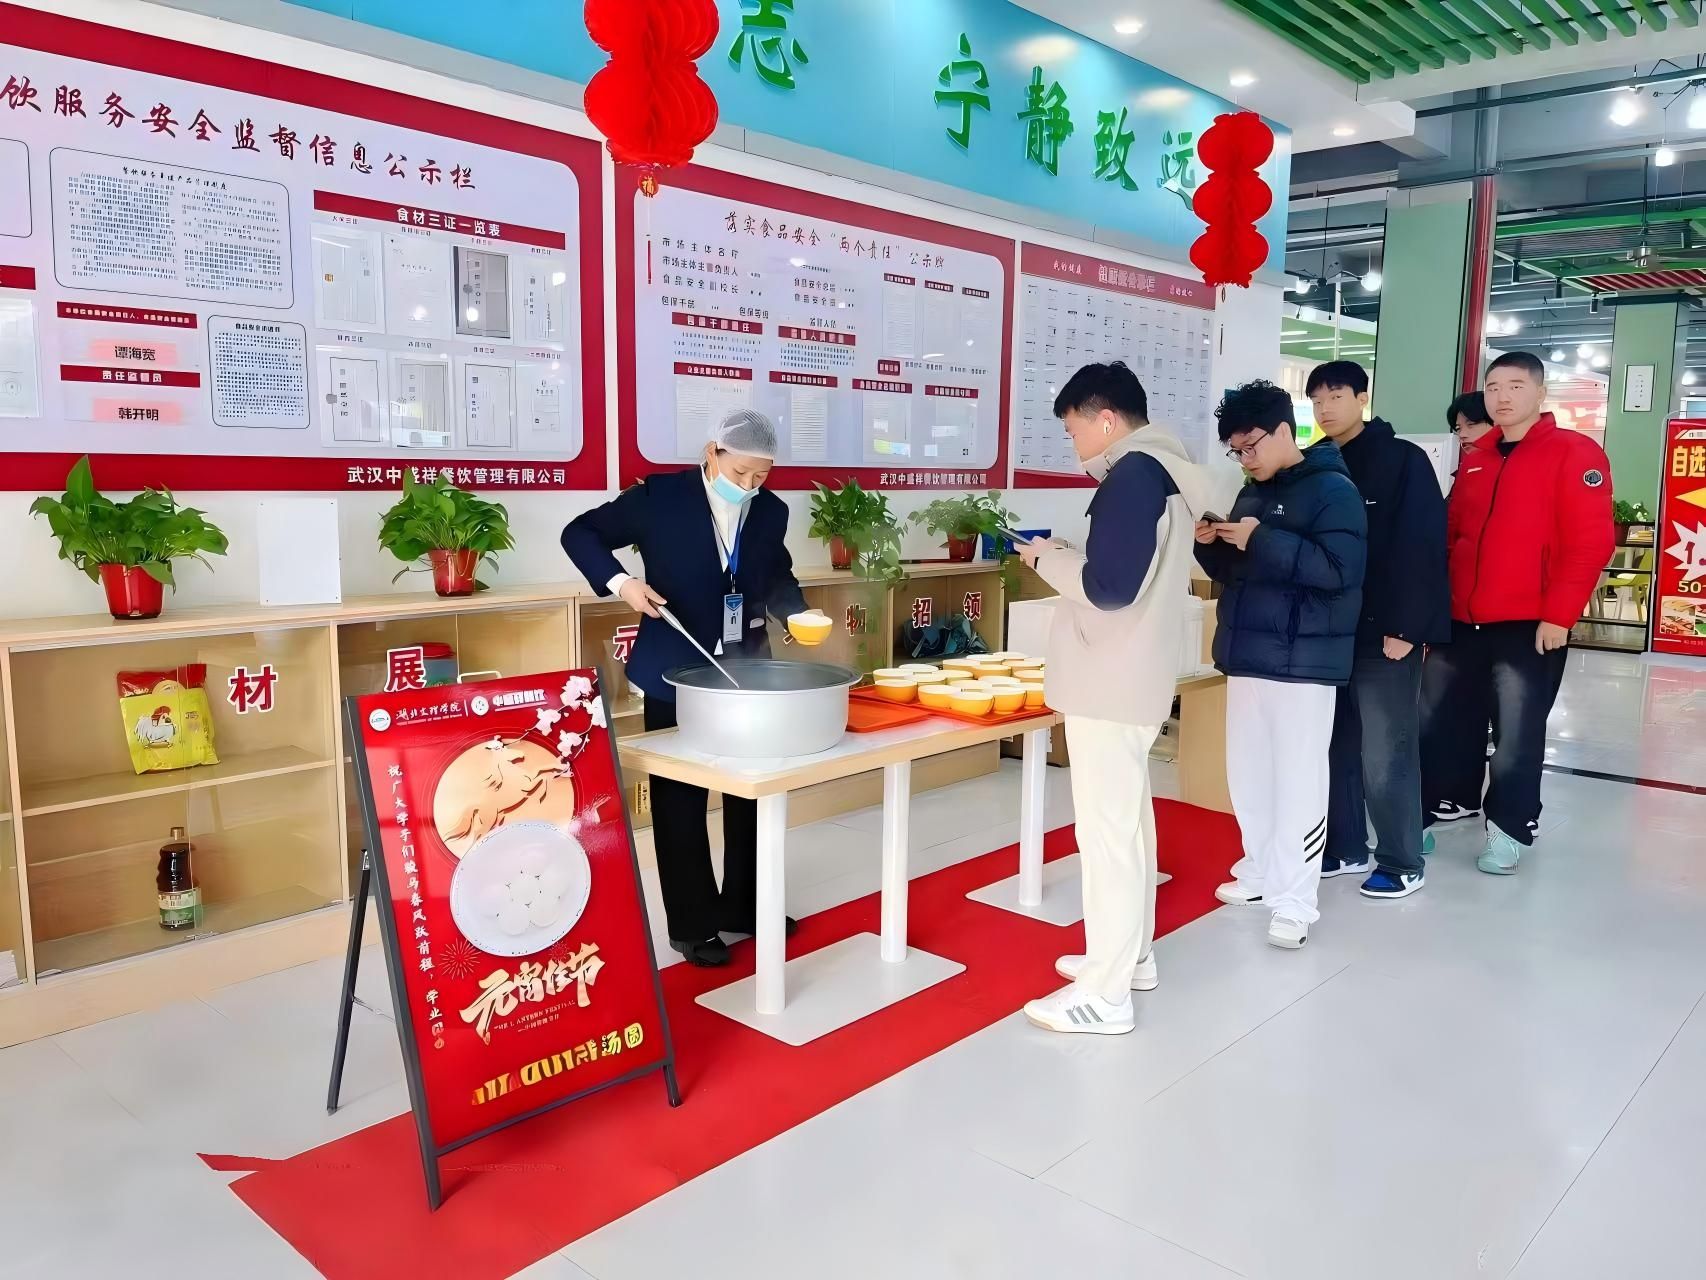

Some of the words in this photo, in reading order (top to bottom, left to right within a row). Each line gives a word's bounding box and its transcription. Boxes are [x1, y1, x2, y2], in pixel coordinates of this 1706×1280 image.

[728, 0, 808, 90] 志
[0, 75, 476, 189] 饮服务安全监督信息公示栏
[397, 207, 501, 237] 食材三证一览表
[118, 407, 159, 421] 韩开明
[1672, 446, 1706, 478] 自选
[912, 598, 932, 628] 招
[963, 592, 982, 621] 领
[227, 664, 279, 714] 材
[384, 646, 427, 694] 展
[459, 941, 606, 1046] 元宵佳节
